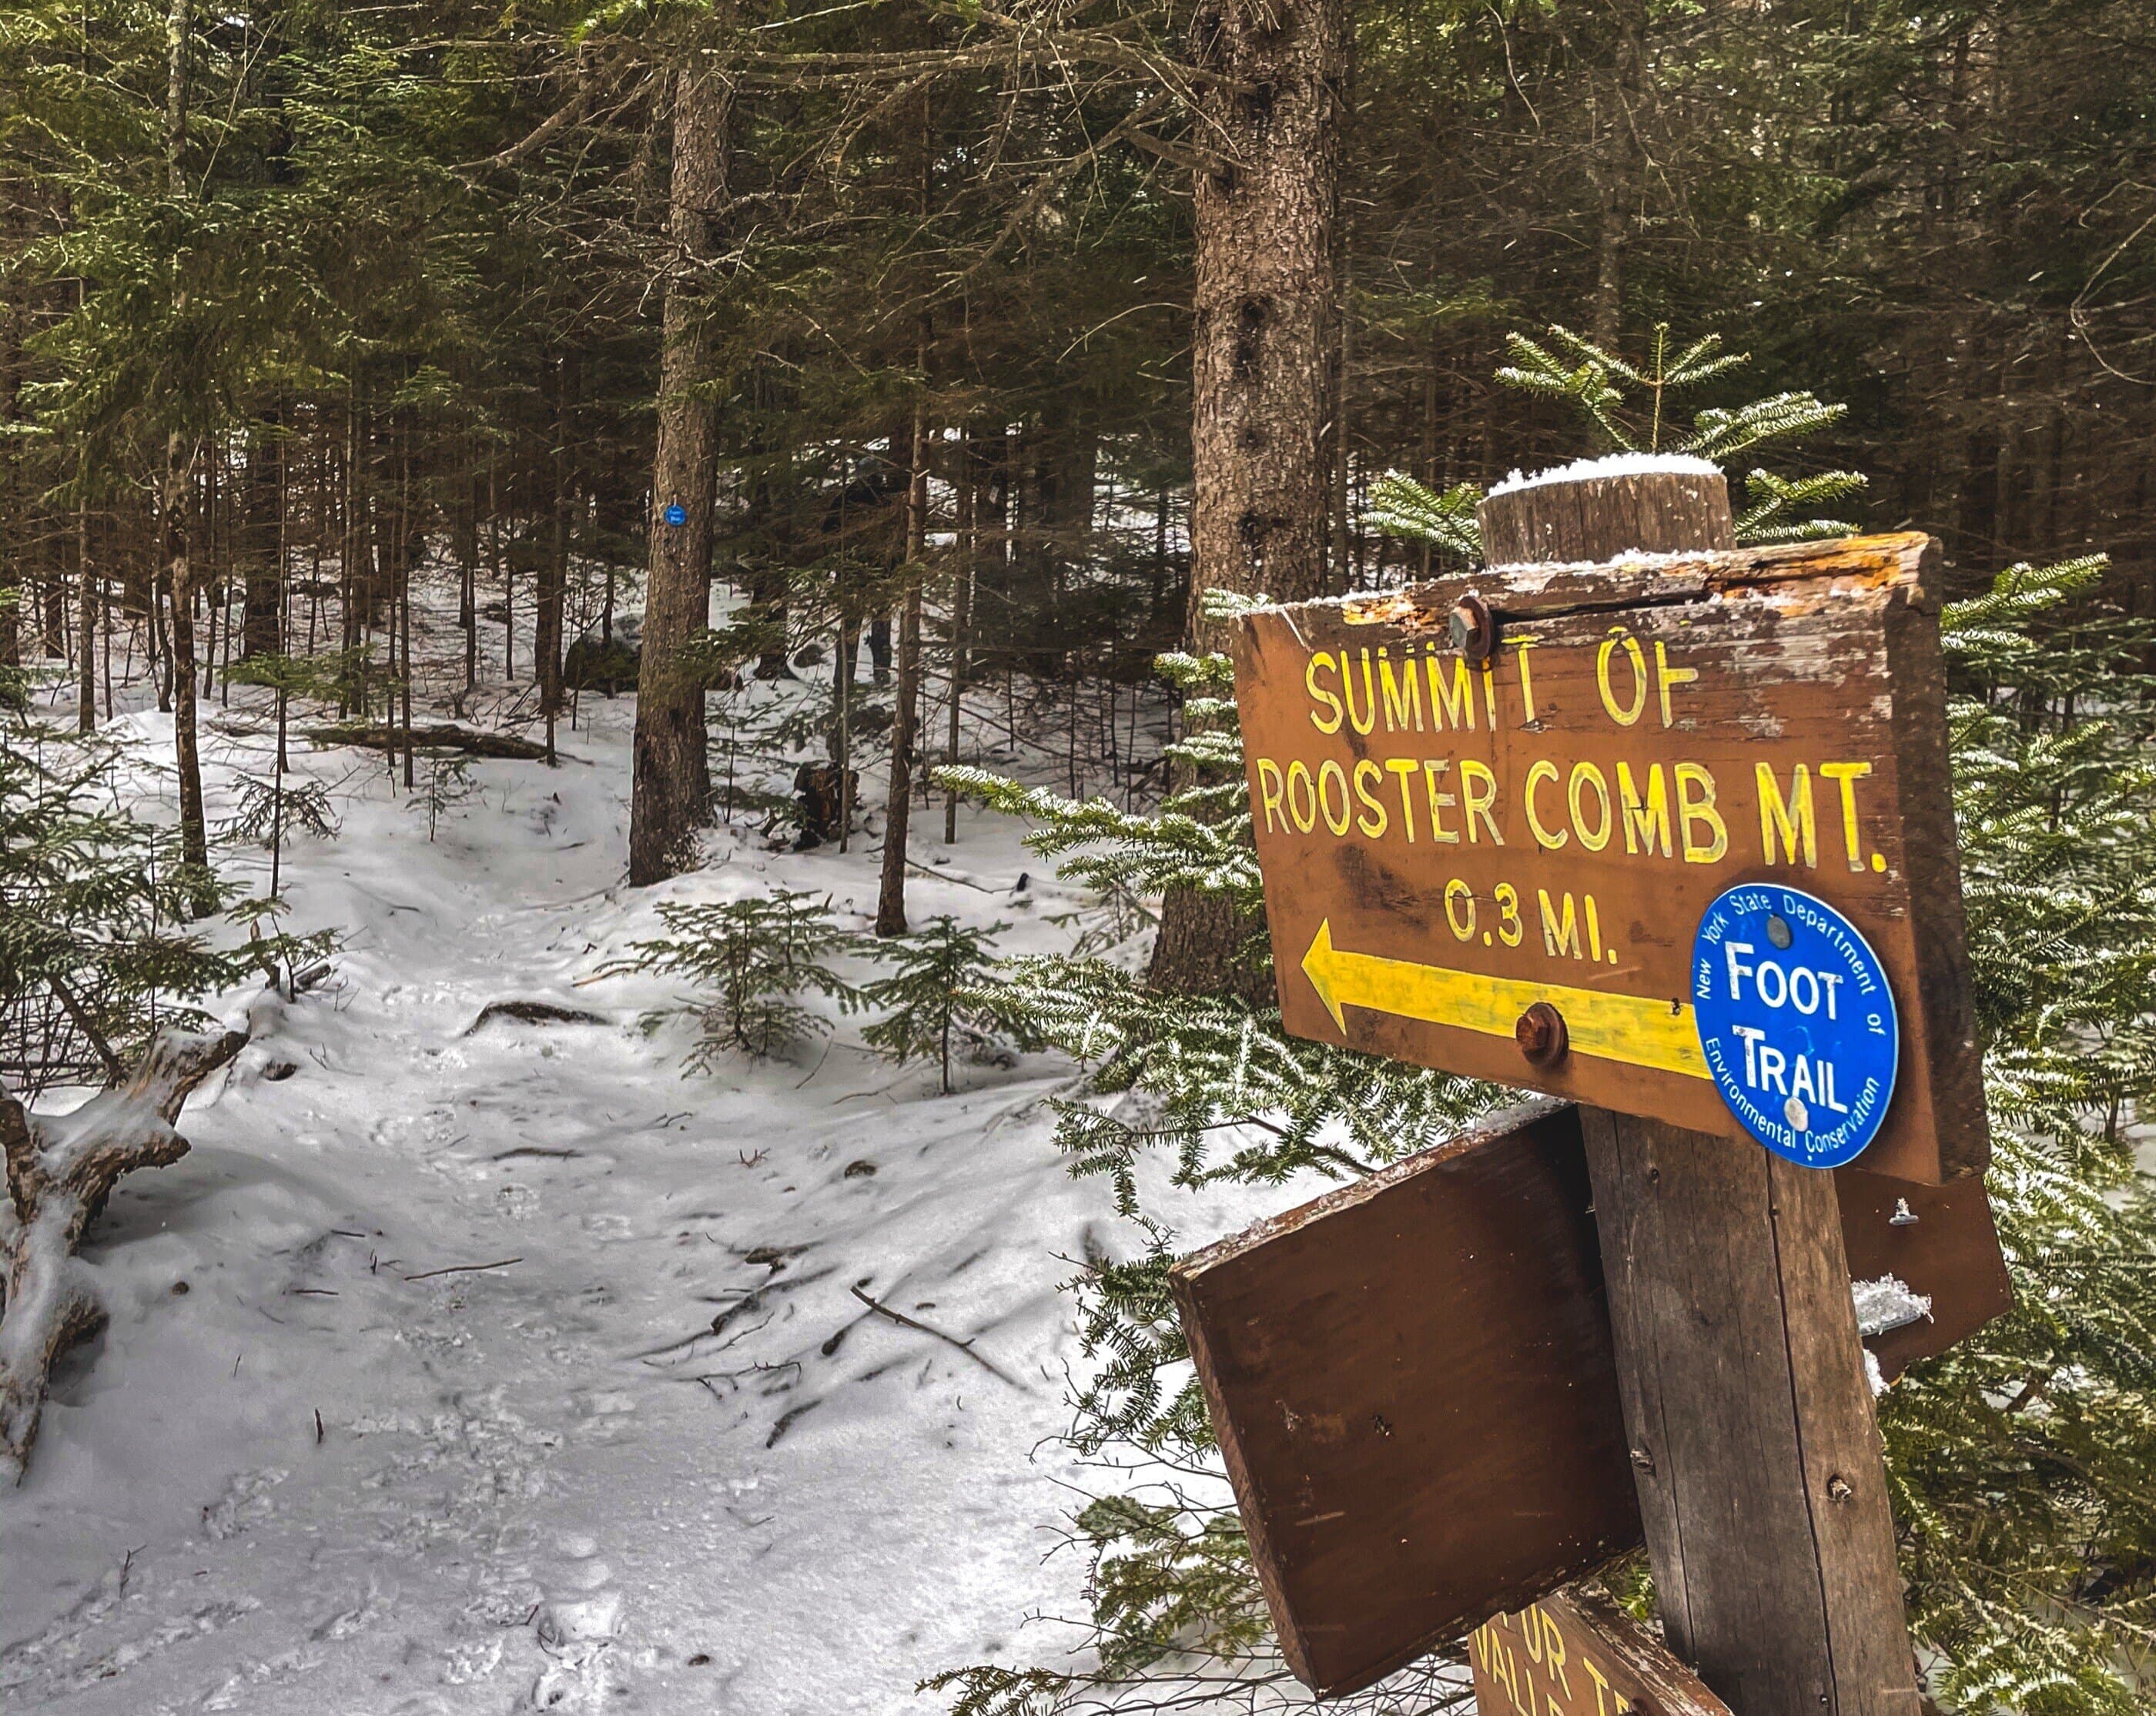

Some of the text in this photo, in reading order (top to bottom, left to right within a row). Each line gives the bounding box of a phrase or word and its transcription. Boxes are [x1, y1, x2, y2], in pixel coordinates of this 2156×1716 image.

[1306, 625, 1699, 735] SUMMIT OF
[1257, 758, 1888, 875] ROOSTER COMB MT.
[1444, 878, 1619, 965] 0.3 MI.
[1696, 892, 1886, 1036] New York State Department of
[1724, 941, 1844, 1020] FOOT
[1705, 1037, 1881, 1155] Environmental Conservation
[1732, 1025, 1848, 1115] TRAIL
